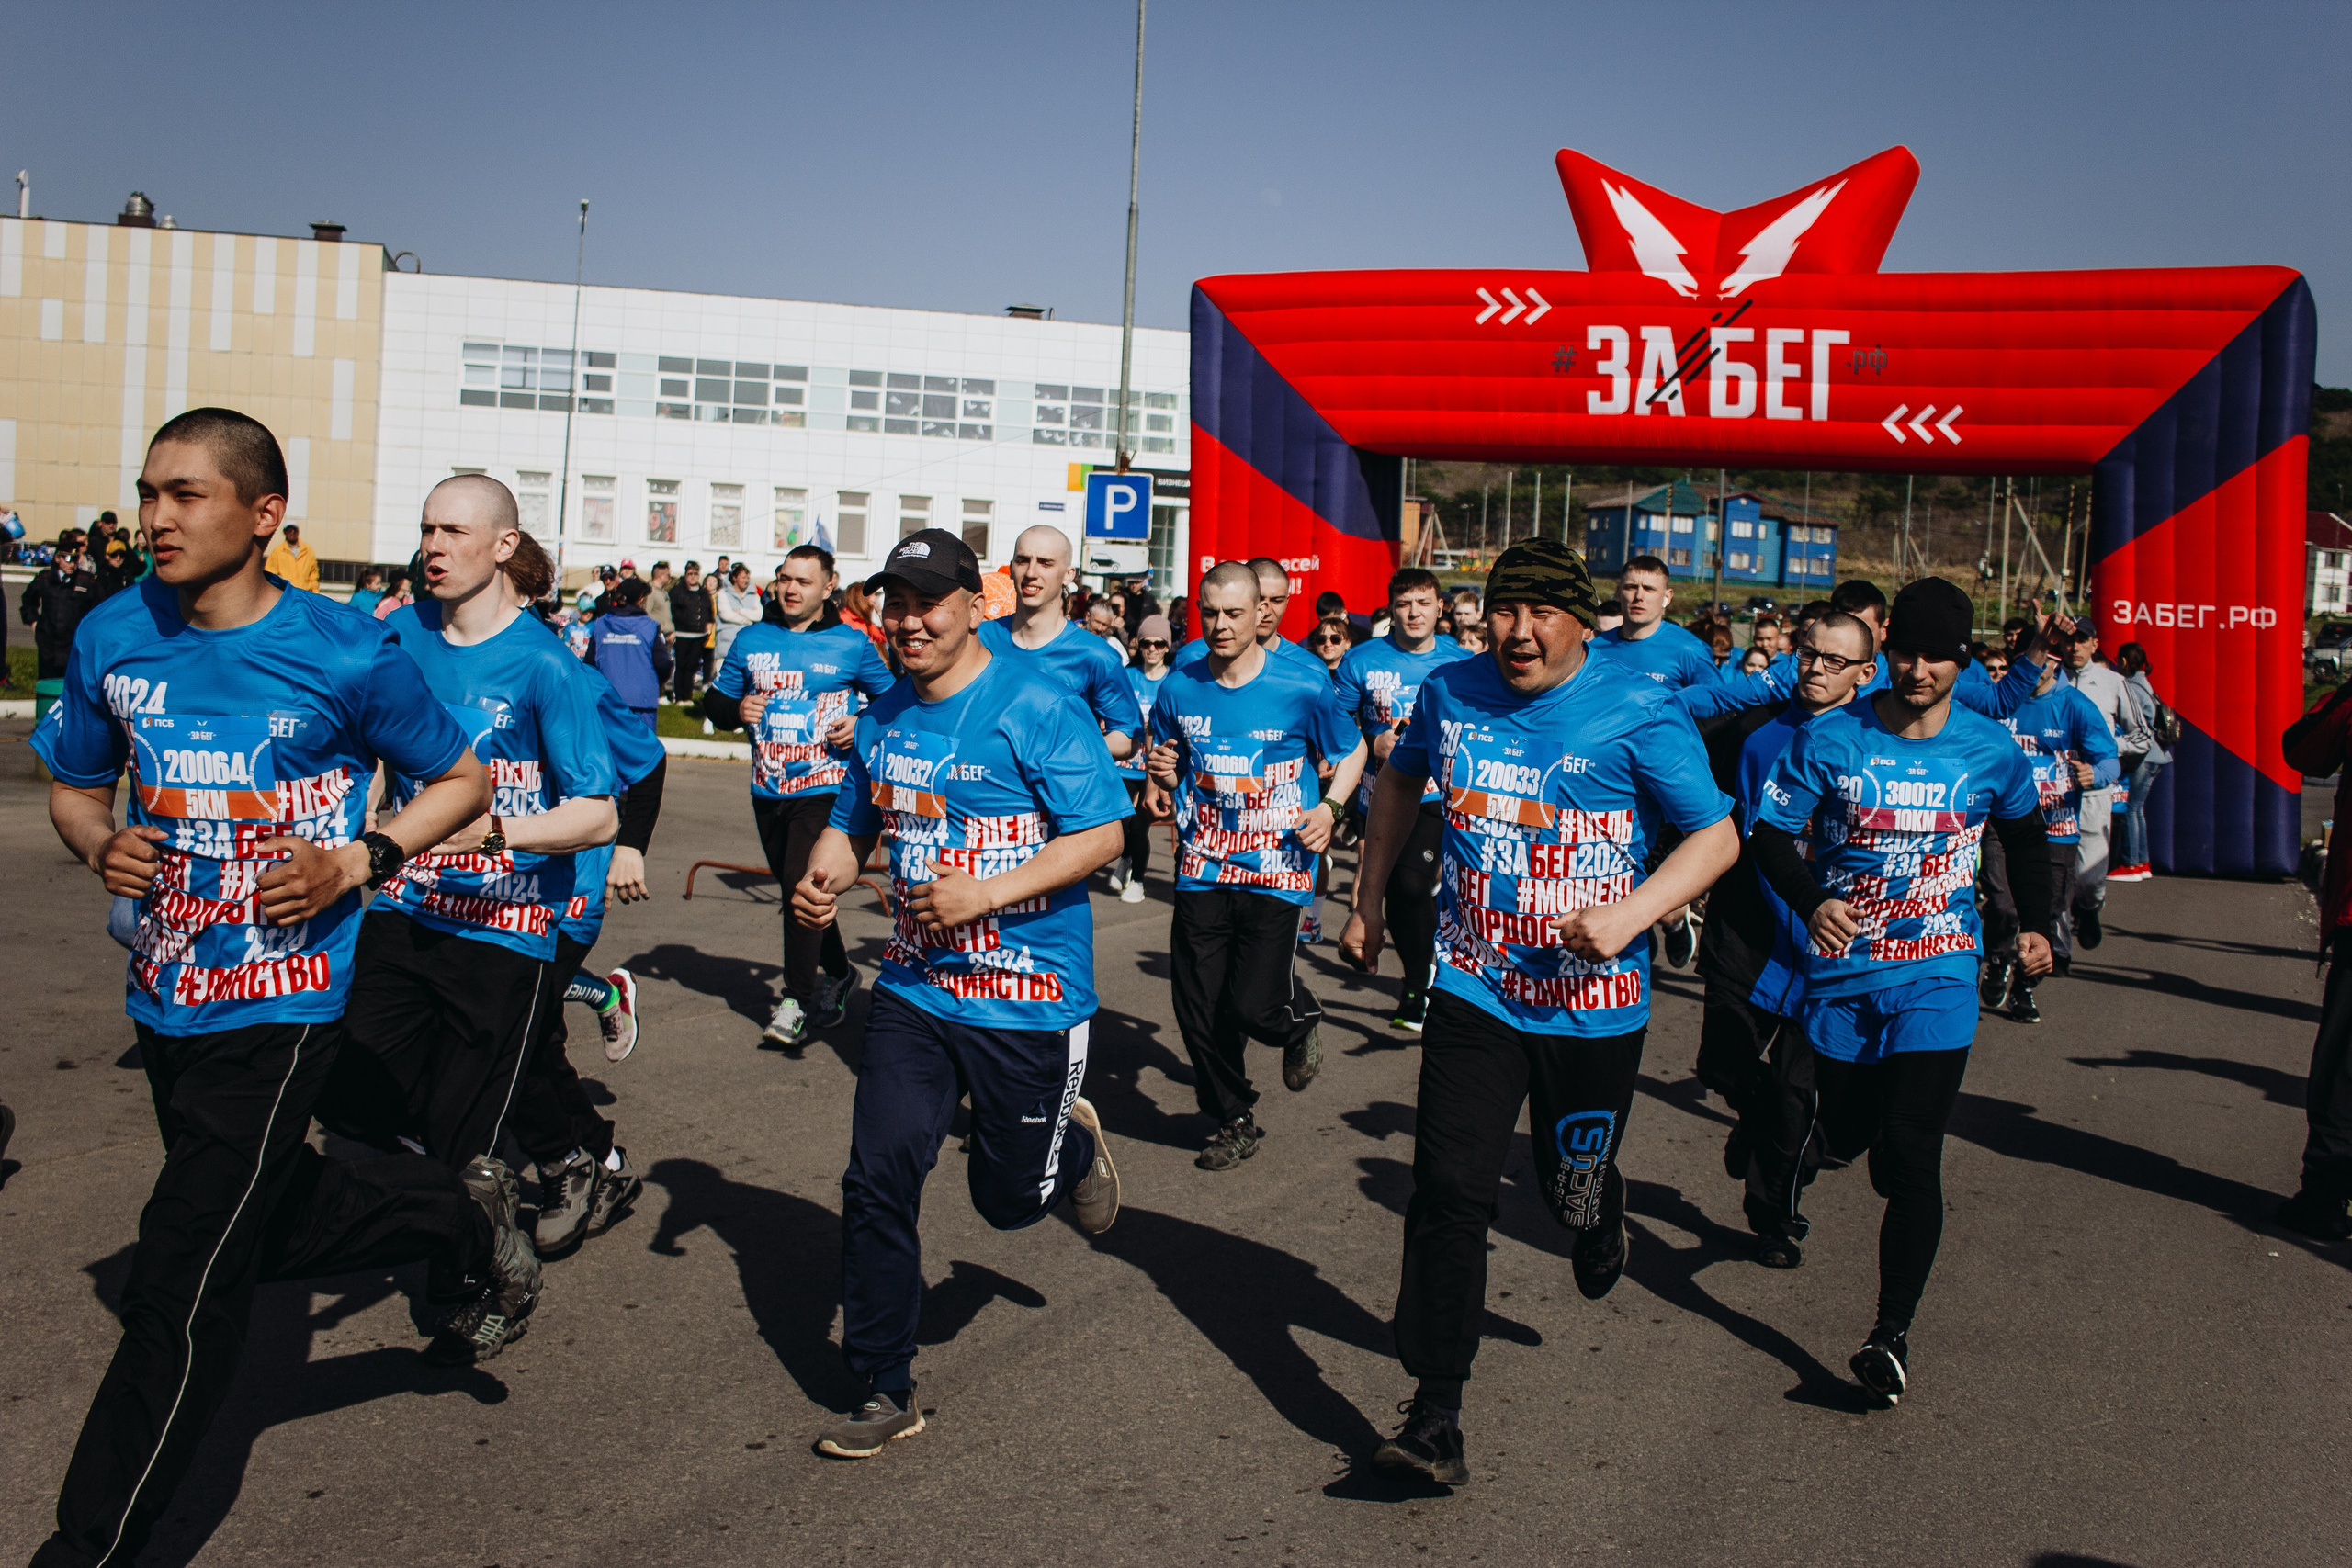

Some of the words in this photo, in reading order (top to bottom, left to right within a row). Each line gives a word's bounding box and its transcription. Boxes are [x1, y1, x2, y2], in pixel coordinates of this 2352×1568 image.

[1105, 484, 1137, 530] P
[2112, 600, 2277, 629] ЗАБЕГ.РФ
[747, 653, 780, 671] 2024
[752, 671, 804, 690] #МЕЧТА
[1366, 671, 1401, 690] 2024
[103, 673, 168, 719] 2024
[154, 719, 175, 728] ПСБ
[269, 717, 300, 738] БЕГ
[769, 713, 805, 729] 40006
[1477, 734, 1494, 742] ПСБ
[163, 749, 252, 785] 20064
[885, 753, 933, 788] 20032
[1204, 754, 1249, 774] 20060
[1475, 760, 1541, 796] 20033
[1563, 755, 1590, 774] БЕГ
[779, 767, 847, 795] #ЕДИНСТВ
[1763, 779, 1792, 807] ПСБ
[1838, 775, 1862, 802] 20
[1885, 780, 1946, 807] 30012
[964, 812, 1049, 849] #ЦЕЛЬ
[1238, 806, 1303, 831] #МОМЕН
[1559, 809, 1633, 844] #ЦЕЛЬ
[900, 843, 1046, 881] #ЗАБЕГ202
[1181, 854, 1207, 879] БЕГ
[1260, 850, 1302, 873] 2024
[479, 873, 542, 904] 2024
[1517, 872, 1634, 914] #МОМЕНТ
[1457, 899, 1567, 949] #ГОРДОС
[1501, 969, 1641, 1010] #ЕДИНСТВО
[1055, 1059, 1084, 1146] Reebok
[1021, 1115, 1047, 1123] Reebok
